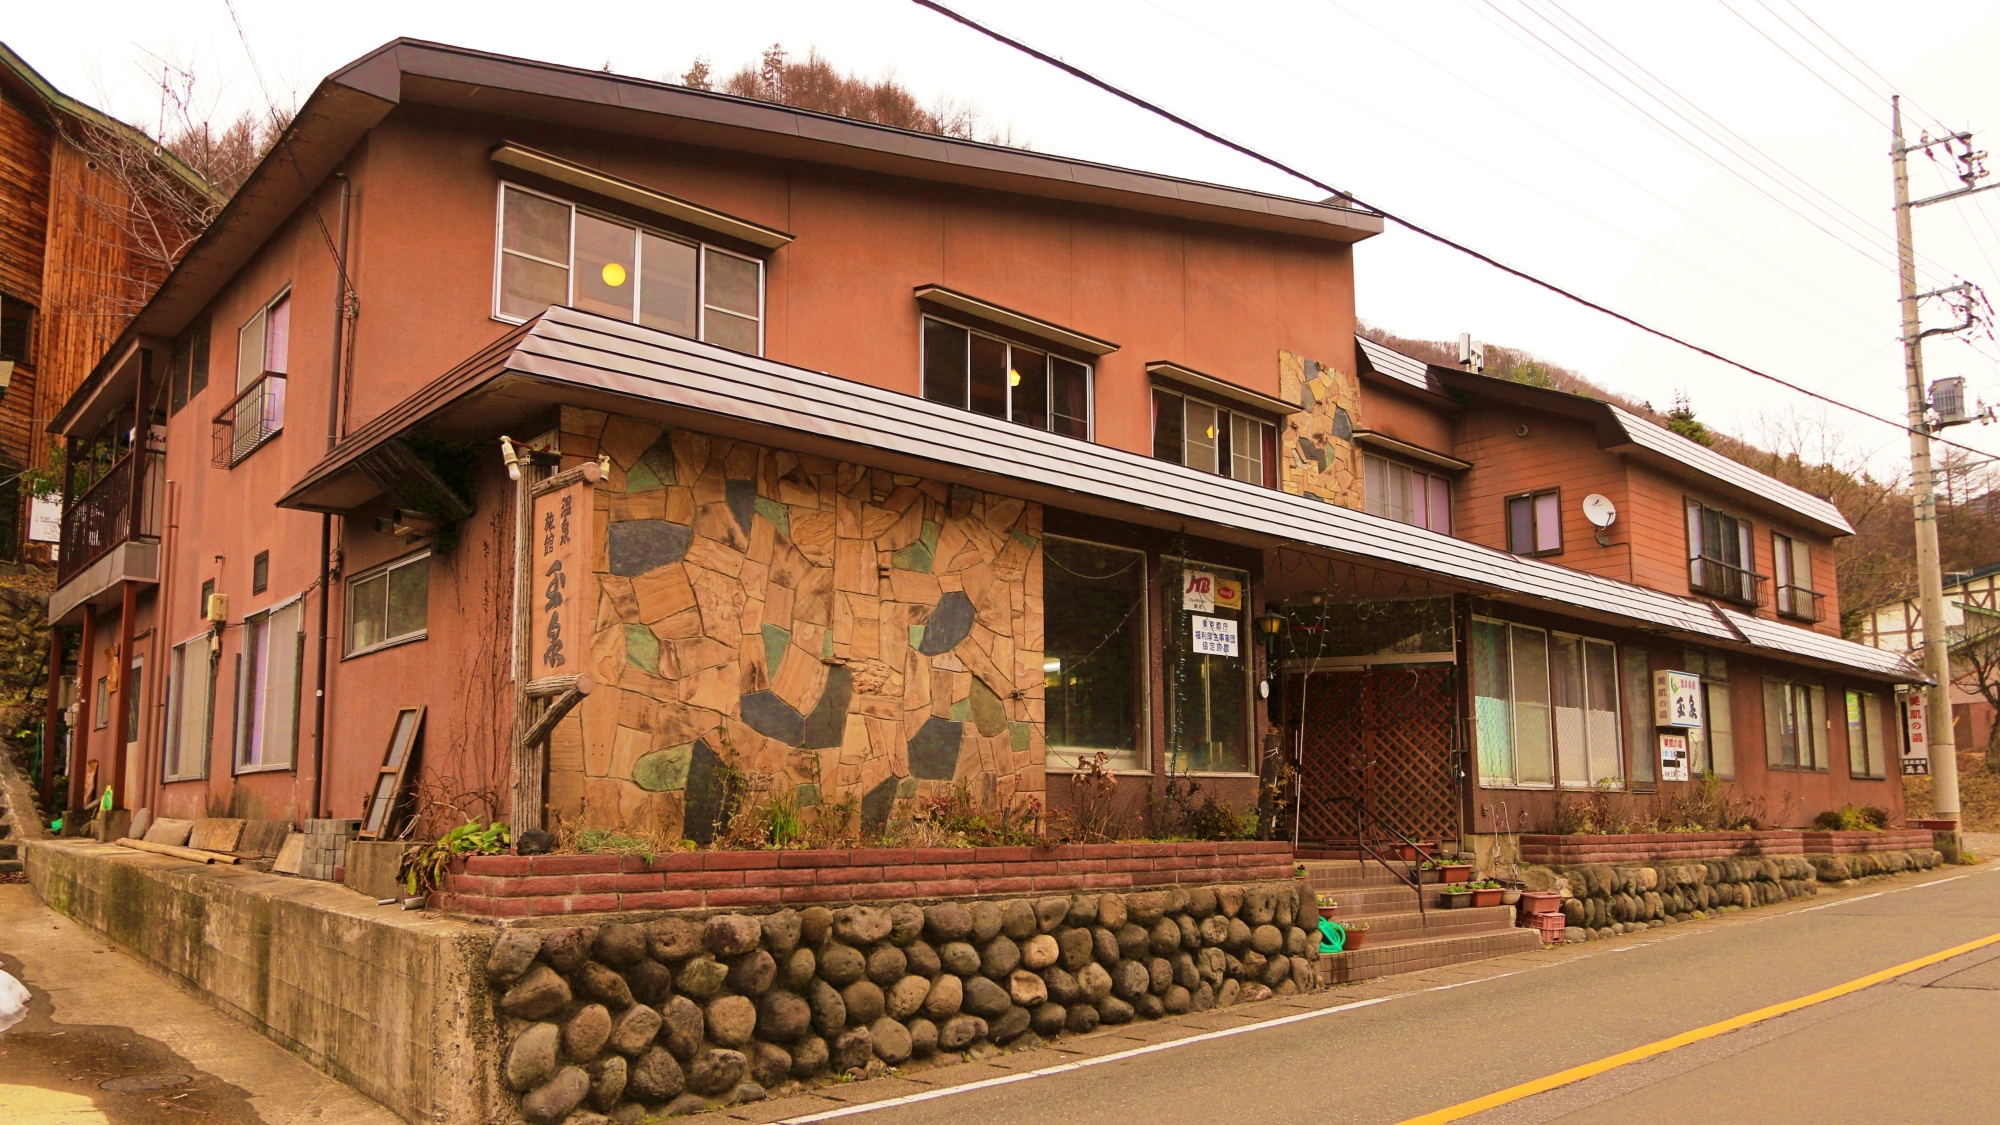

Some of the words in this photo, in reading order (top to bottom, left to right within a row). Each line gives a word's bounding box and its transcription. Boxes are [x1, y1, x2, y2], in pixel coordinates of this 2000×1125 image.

[543, 511, 556, 557] 旅館
[560, 494, 572, 546] 温泉
[1185, 577, 1210, 594] JTB
[543, 559, 566, 668] 玉泉
[1202, 619, 1228, 630] 東京都庁
[1195, 630, 1235, 643] 福利厚生事業団
[1676, 694, 1698, 719] 玉泉
[1909, 696, 1923, 742] 美肌の湯
